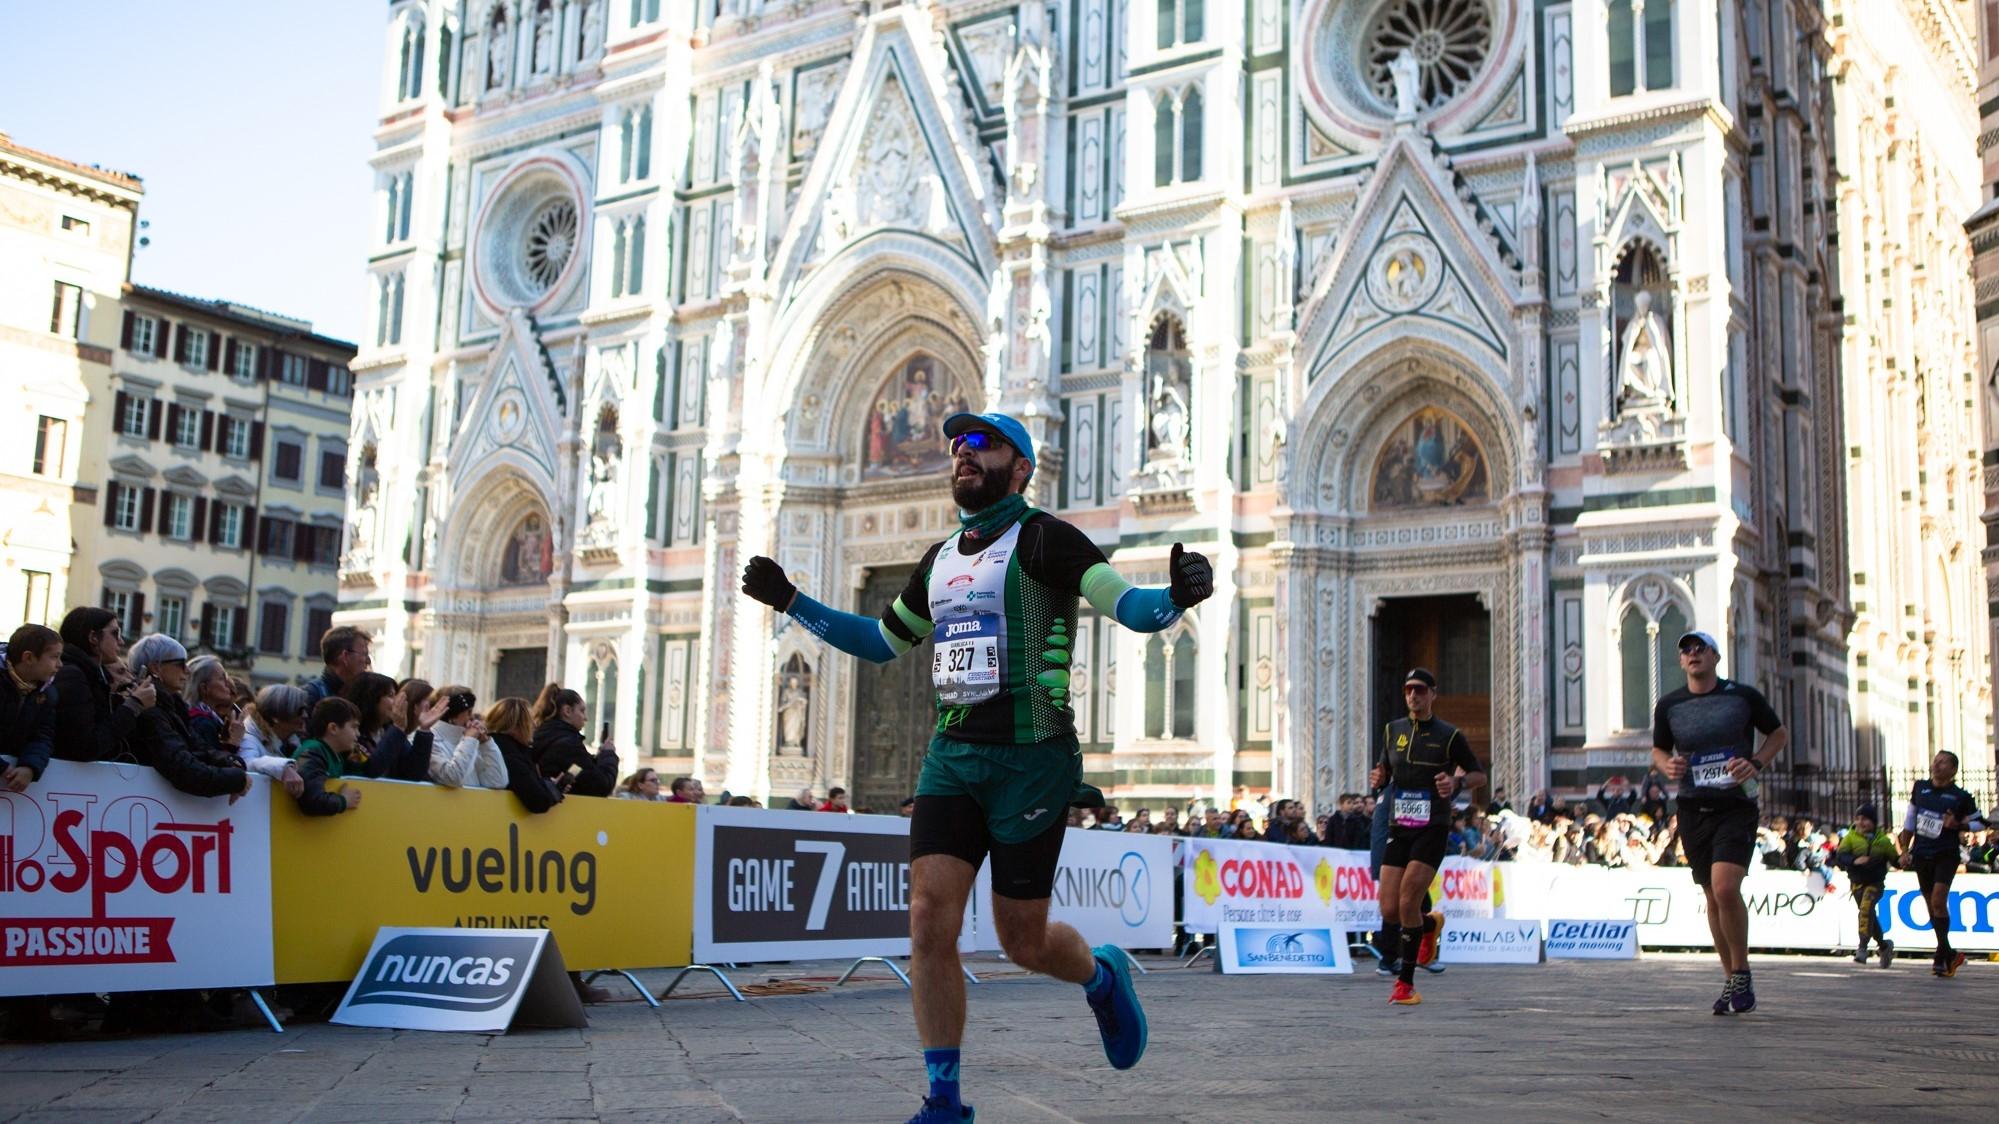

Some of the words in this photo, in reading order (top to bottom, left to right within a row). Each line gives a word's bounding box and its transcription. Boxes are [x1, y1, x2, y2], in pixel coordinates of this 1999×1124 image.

[948, 646, 975, 672] 327
[1702, 765, 1729, 781] 2974
[1401, 802, 1422, 815] 5966
[406, 822, 597, 916] vueling
[1221, 859, 1304, 899] CONAD
[1335, 866, 1381, 901] CON
[728, 858, 795, 912] GAME
[794, 839, 846, 931] 7
[1443, 869, 1489, 901] CONAD
[5, 926, 151, 957] PASSIONE
[1447, 930, 1516, 944] SYNLAB
[1547, 940, 1576, 950] keep
[1578, 941, 1624, 952] moving
[1550, 921, 1634, 940] Cetilar
[375, 953, 516, 986] nuncas
